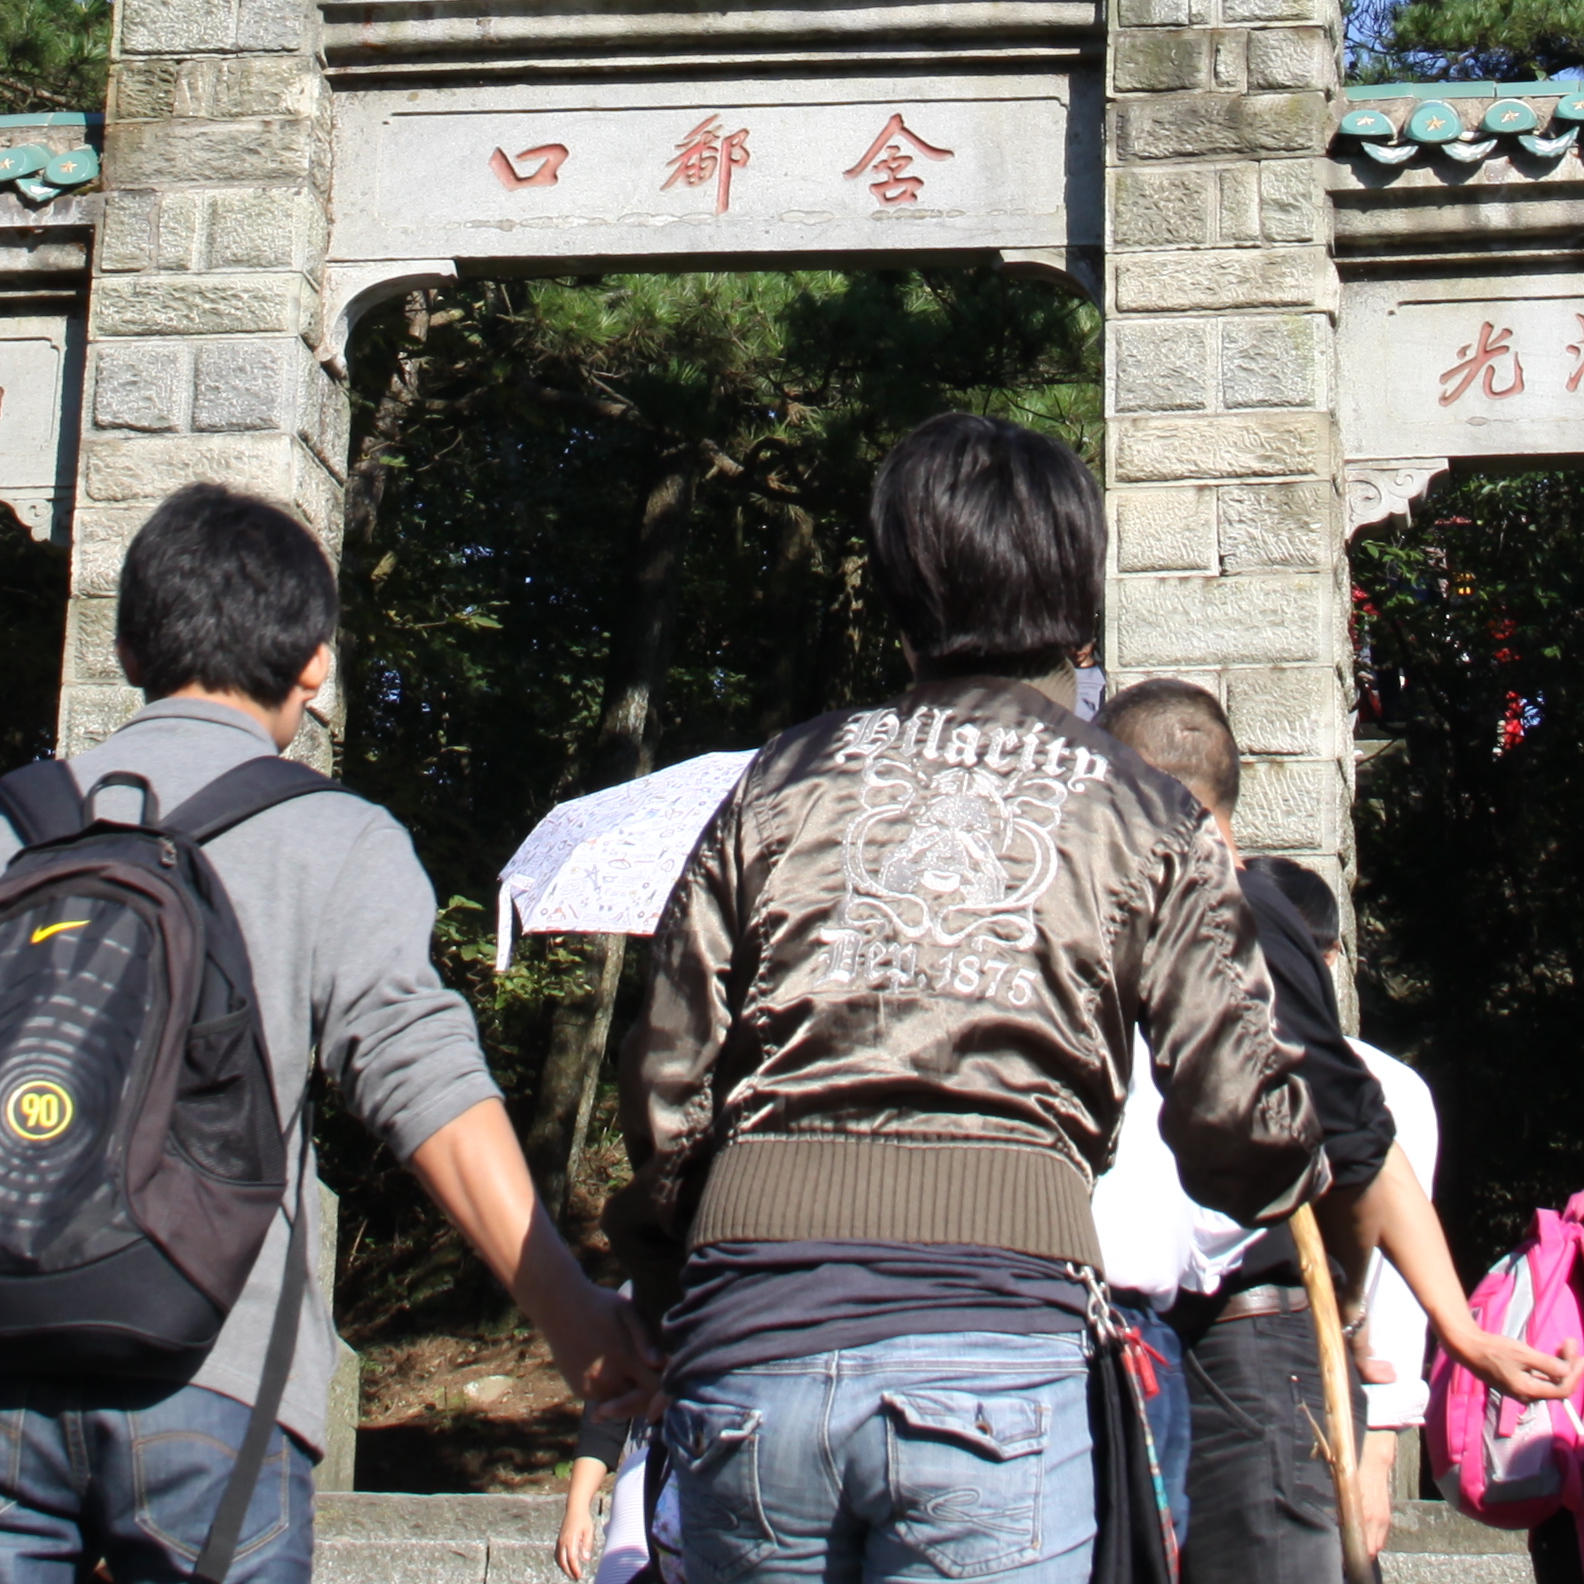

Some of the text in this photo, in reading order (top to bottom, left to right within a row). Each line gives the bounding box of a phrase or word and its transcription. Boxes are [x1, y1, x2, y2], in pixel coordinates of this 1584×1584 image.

[834, 706, 1109, 793] Hilarity
[937, 952, 1037, 1005] 1875
[21, 1092, 59, 1128] 90
